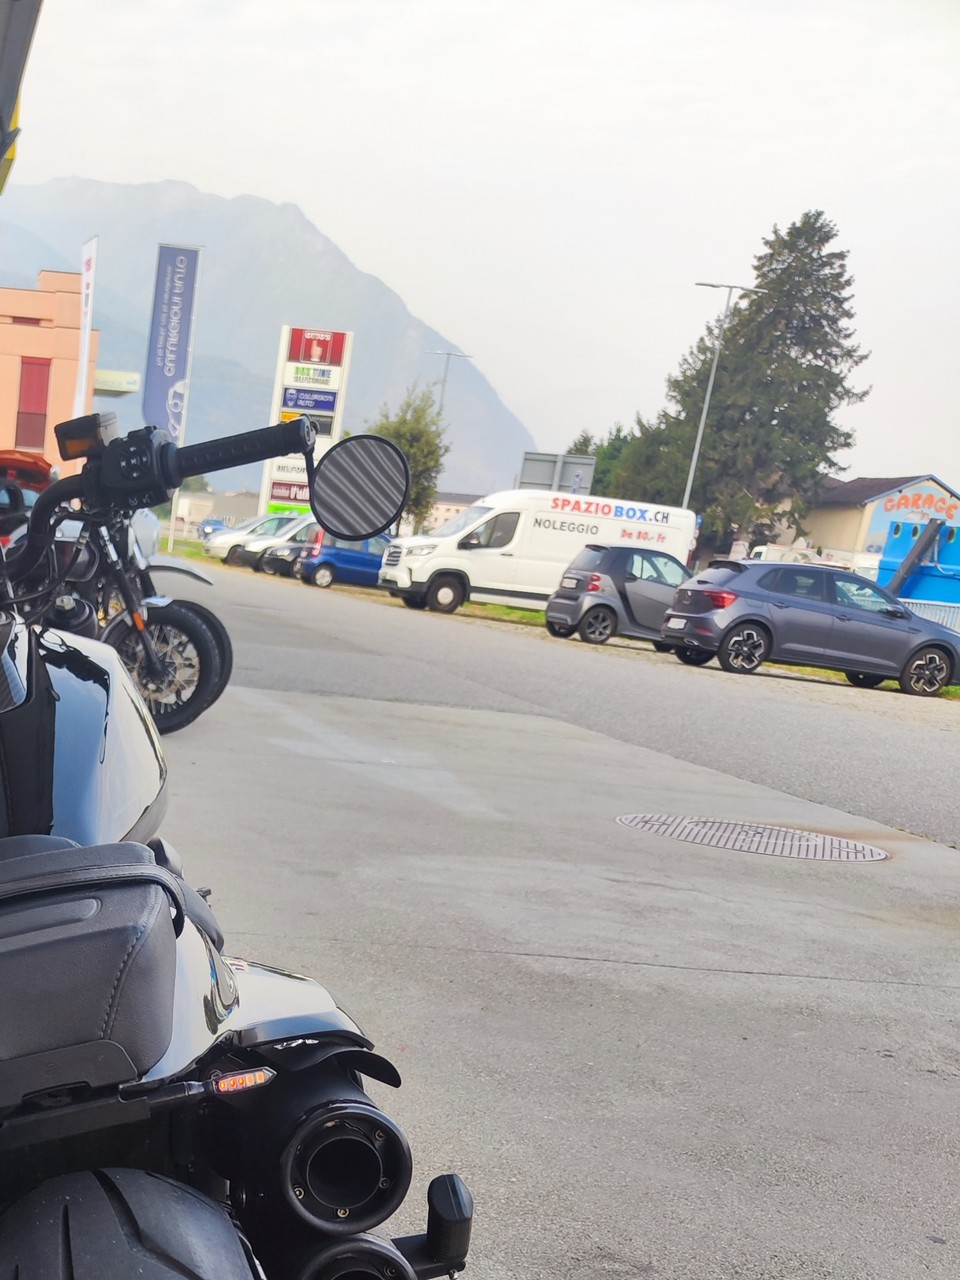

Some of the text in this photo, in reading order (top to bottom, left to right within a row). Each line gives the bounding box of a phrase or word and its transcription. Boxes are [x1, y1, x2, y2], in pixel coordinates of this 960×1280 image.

[551, 498, 670, 523] SPAZIOBOX.CH
[884, 493, 958, 519] GARAGE
[533, 518, 599, 535] NOLEGGIO
